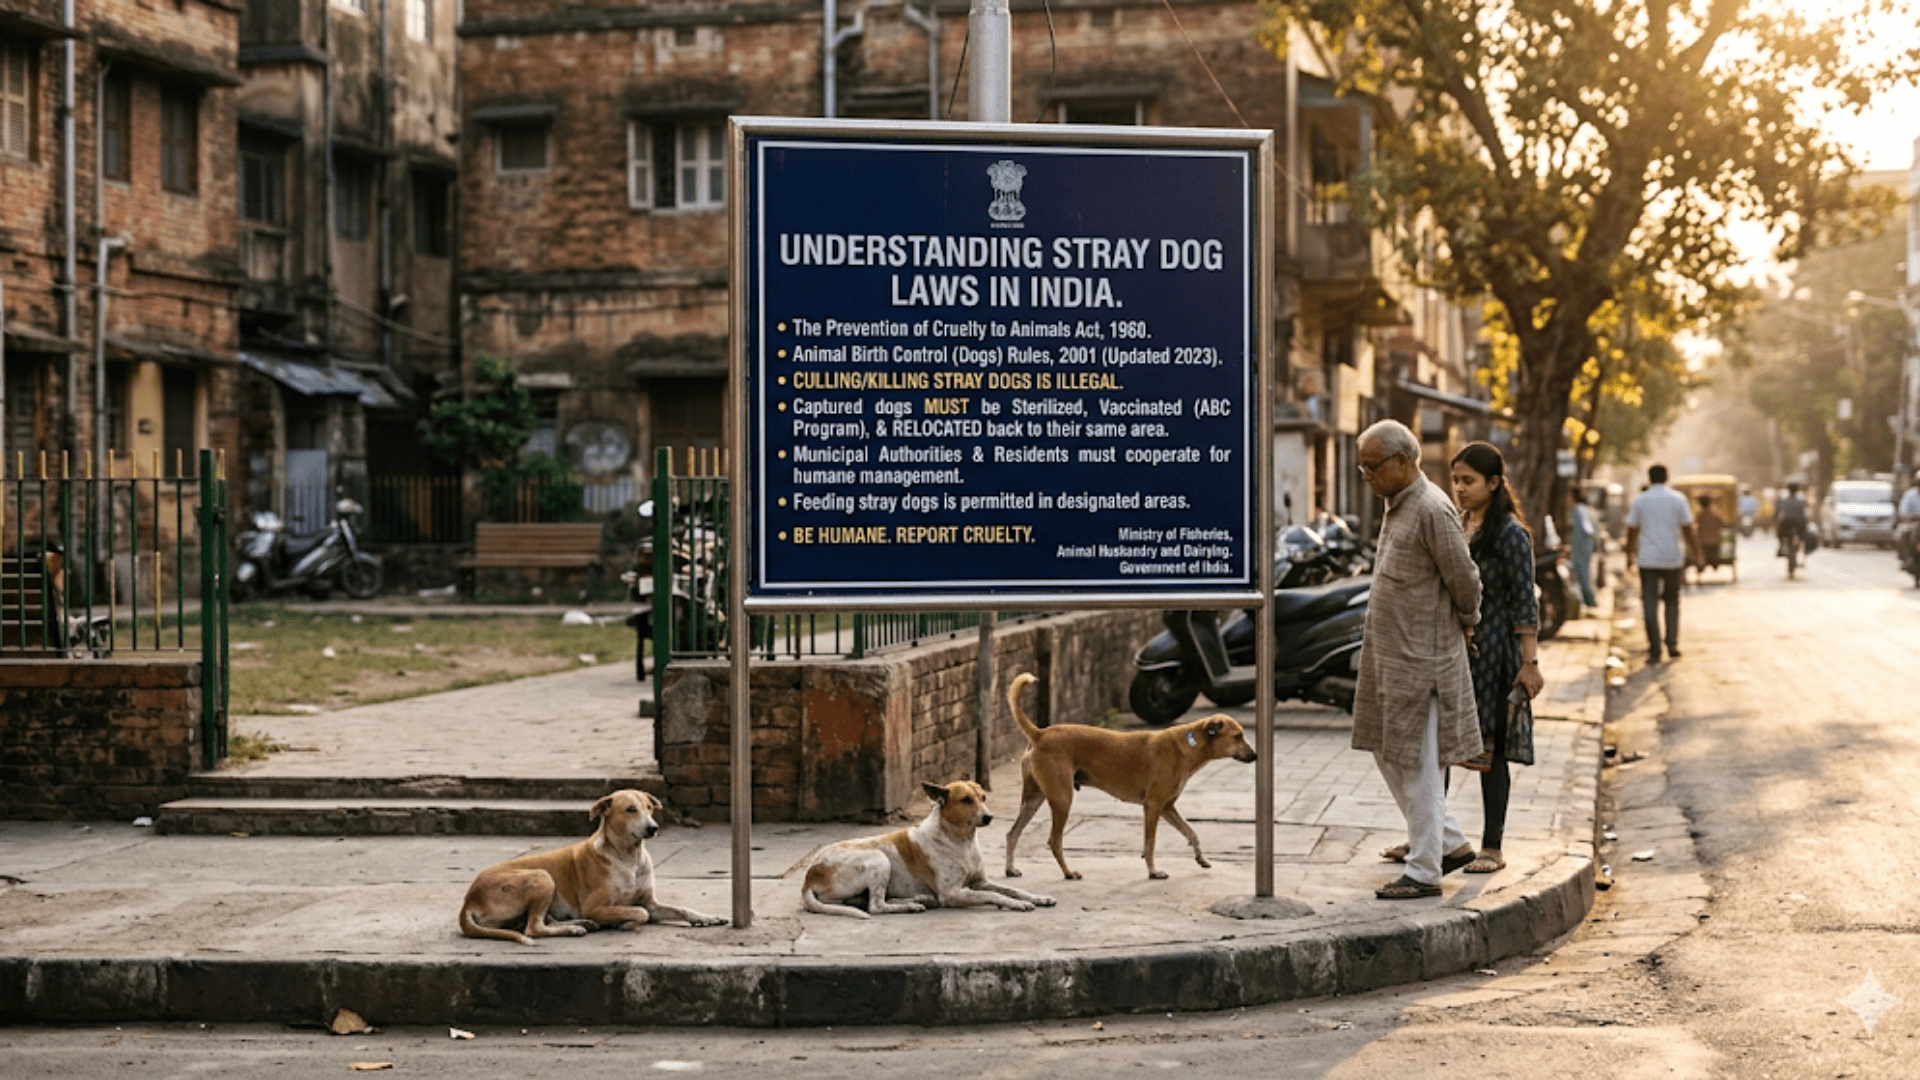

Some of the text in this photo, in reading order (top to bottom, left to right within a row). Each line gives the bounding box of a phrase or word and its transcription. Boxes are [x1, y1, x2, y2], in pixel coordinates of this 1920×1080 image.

[780, 233, 1223, 270] UNDERSTANDING STRAY DOG
[892, 274, 1122, 307] LAWS IN INDIA.
[793, 319, 821, 336] The
[827, 319, 908, 336] Prevention
[914, 320, 928, 336] of
[933, 320, 986, 340] Cruelty
[991, 321, 1006, 336] to
[1010, 321, 1070, 337] Animals
[1075, 321, 1104, 340] Act,
[793, 346, 1222, 367] Animal Birth Control (Dogs) Rules, 2001 (Updated 2023).
[794, 372, 1123, 390] CULLING/KILLING STRAY DOGS IS ILLEGAL.
[794, 398, 1230, 419] Captured dogs MUST be Sterilized, Vaccinated (ABC
[794, 419, 1168, 440] Program), & RELOCATED back to their same area.
[794, 446, 1231, 465] Municipal Authorities & Residents must cooperate for
[794, 468, 964, 487] humane management.
[794, 492, 1190, 514] Feeding stray dogs is permitted in designated areas.
[794, 526, 1034, 543] BE HUMANE. REPORT CRUELTY.
[1118, 527, 1163, 543] Ministry
[1166, 528, 1176, 540] of
[1057, 545, 1096, 557] Animal
[1161, 545, 1180, 557] and
